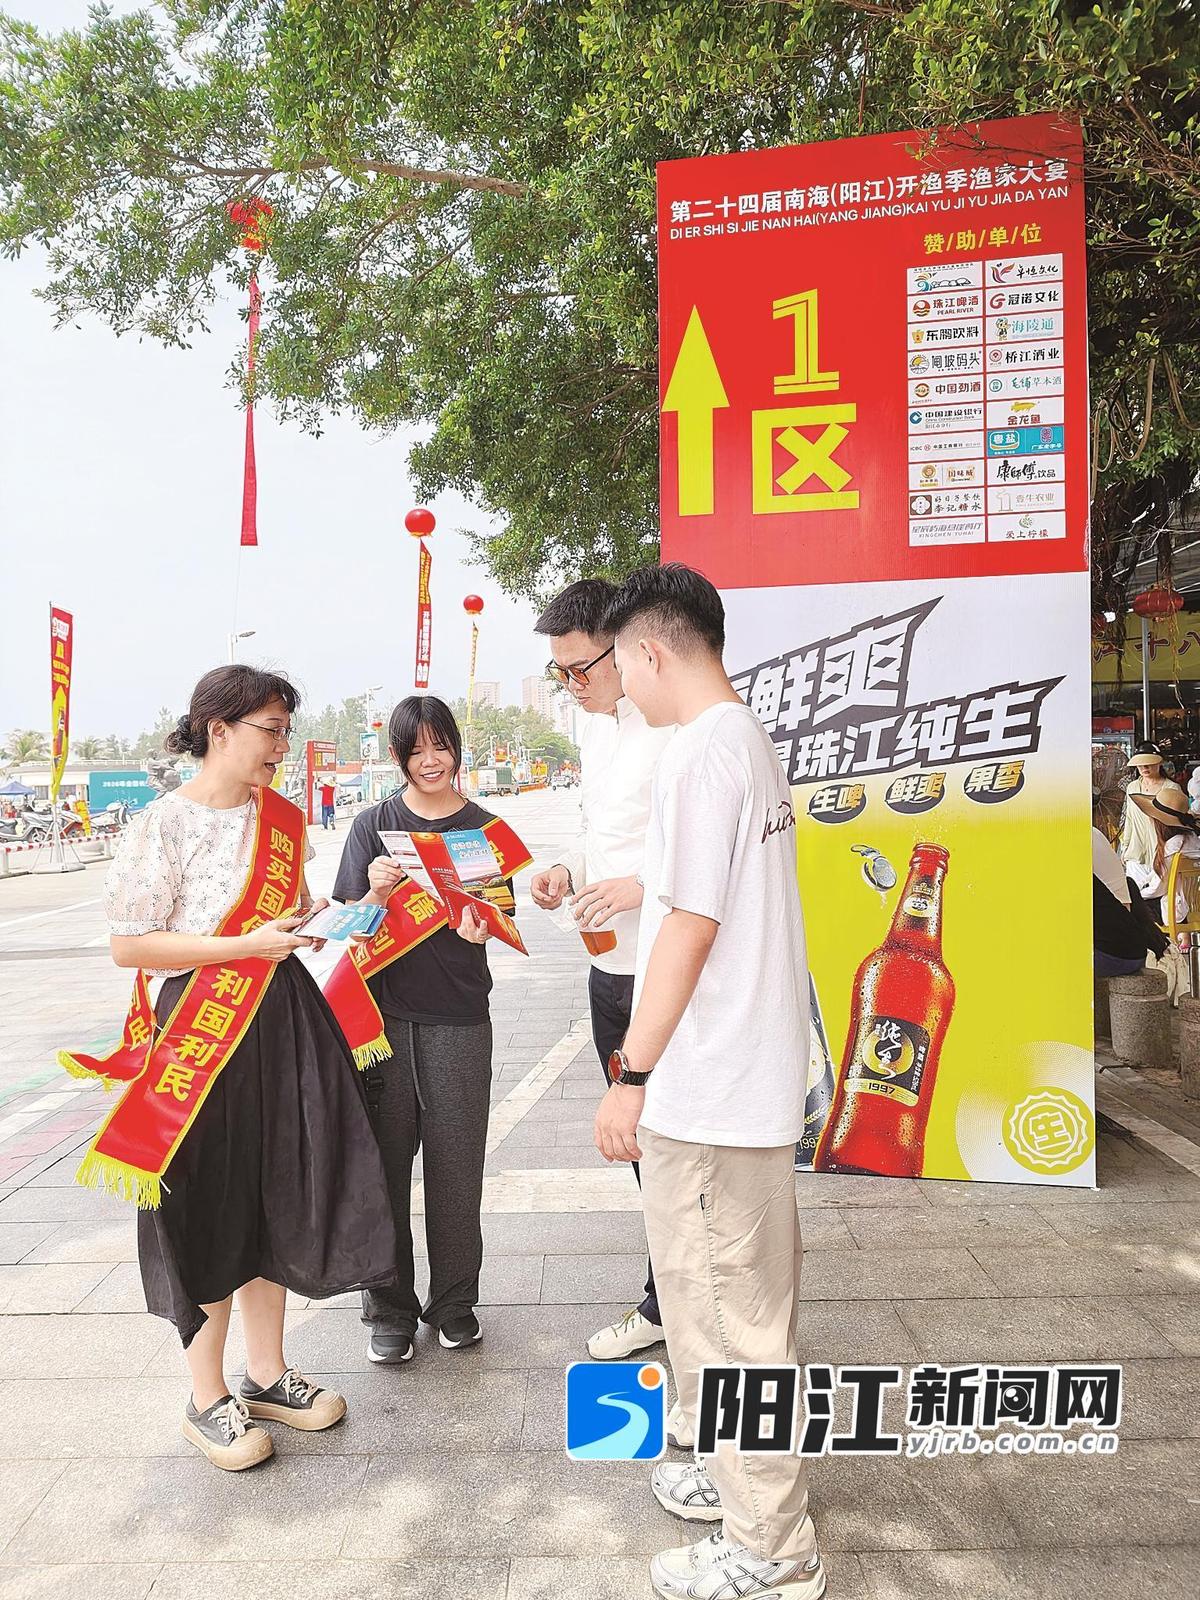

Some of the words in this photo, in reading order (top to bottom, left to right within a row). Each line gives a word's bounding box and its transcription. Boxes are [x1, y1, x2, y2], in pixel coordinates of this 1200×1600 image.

[670, 158, 1069, 223] 第二十四届南海(阳江)开渔季渔家大宴
[670, 228, 683, 239] DI
[686, 226, 701, 238] ER
[704, 224, 724, 236] SHI
[727, 222, 739, 234] SI
[741, 220, 759, 232] JIE
[762, 217, 791, 230] NAN
[932, 198, 951, 211] YU
[954, 197, 965, 209] JI
[969, 195, 987, 208] YU
[991, 192, 1012, 205] JIA
[1015, 190, 1033, 203] DA
[1038, 186, 1068, 200] YAN
[924, 222, 1042, 254] 赞/助/单/位
[933, 295, 979, 309] 珠江啤酒
[1008, 290, 1059, 306] 冠诺文化
[926, 325, 979, 342] 东鹏饮料
[1012, 317, 1054, 333] 海陵通
[1005, 347, 1060, 364] 桥江酒业
[935, 381, 981, 395] 中国劲酒
[925, 407, 982, 418] 中国建设银行
[1007, 414, 1041, 426] 金龙鱼
[966, 760, 1026, 796] 果香
[886, 772, 946, 805] 鲜爽
[809, 784, 866, 816] 生啤
[154, 967, 254, 1102] 利国利民
[868, 1082, 896, 1095] 1997
[800, 1136, 820, 1150] 199
